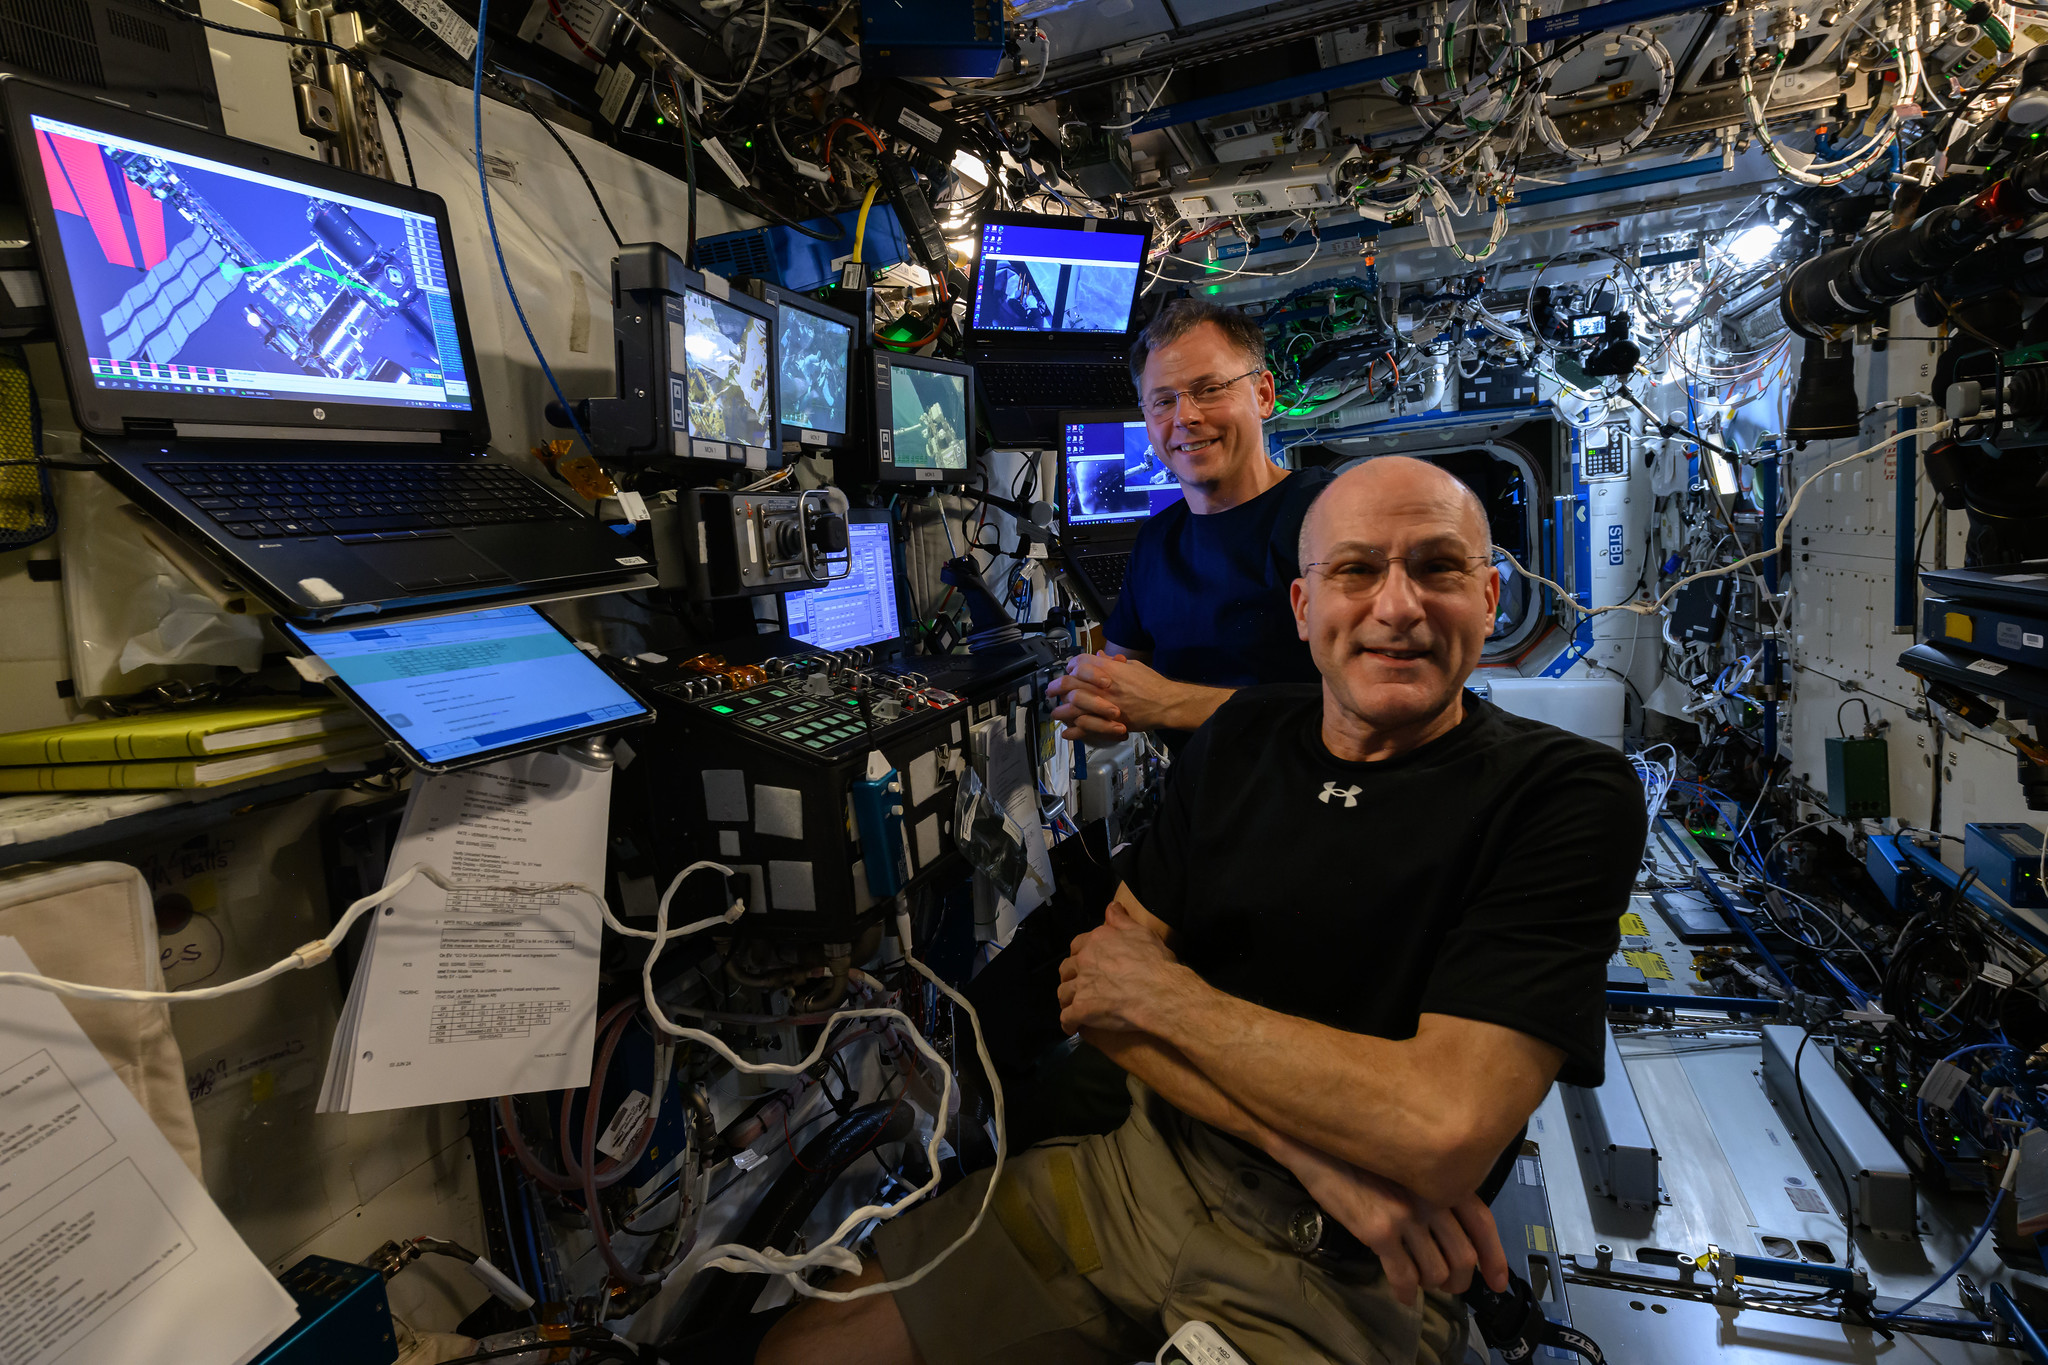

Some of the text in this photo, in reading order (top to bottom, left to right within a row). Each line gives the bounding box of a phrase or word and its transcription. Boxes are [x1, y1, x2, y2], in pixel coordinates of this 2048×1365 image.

[1609, 527, 1623, 564] STBD
[1218, 1346, 1231, 1359] CDN
[1559, 1330, 1602, 1364] PETZL
